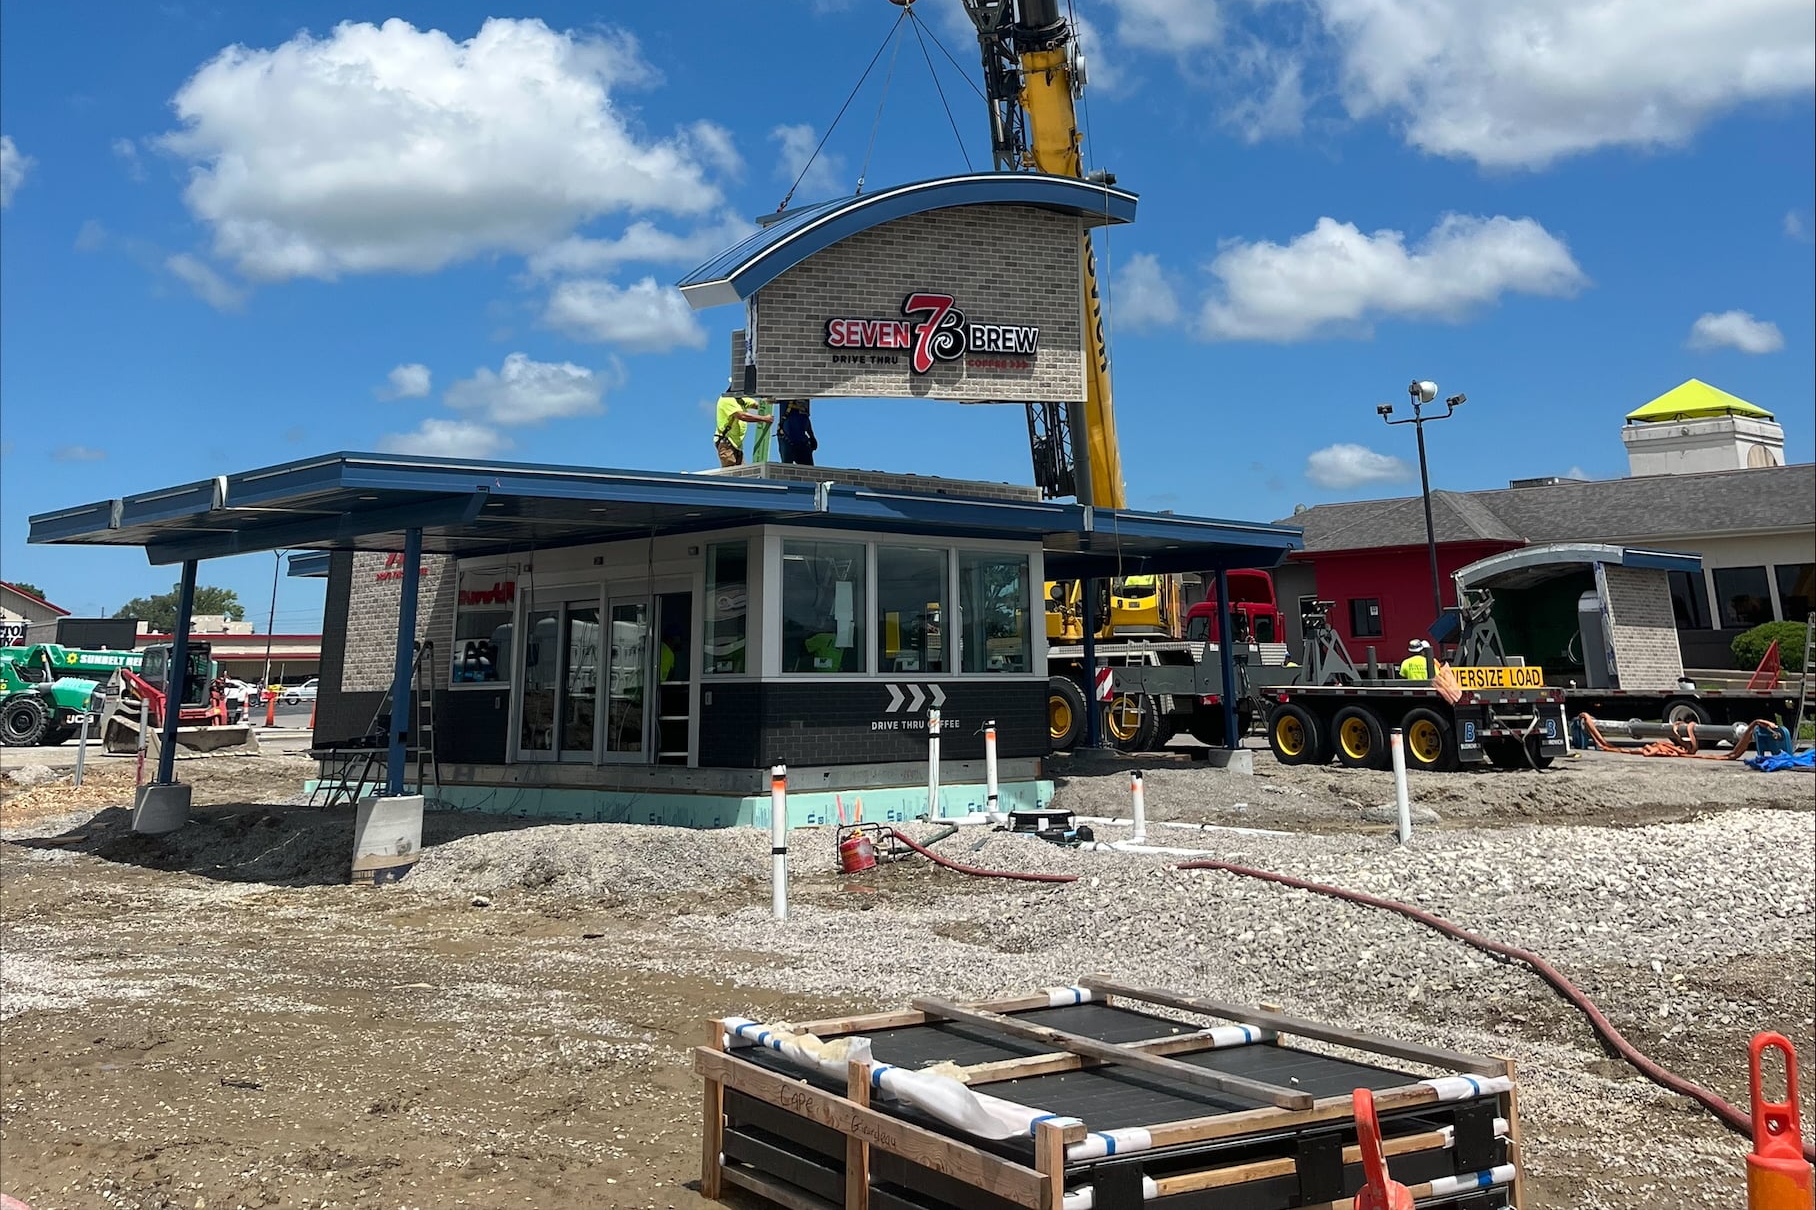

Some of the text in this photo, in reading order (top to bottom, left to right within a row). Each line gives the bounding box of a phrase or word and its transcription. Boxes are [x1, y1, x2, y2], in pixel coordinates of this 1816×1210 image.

[828, 318, 911, 349] SEVEN
[969, 323, 1039, 355] BREW
[832, 355, 866, 364] DRIVE
[870, 356, 899, 365] THRU
[80, 654, 125, 666] SUNBELT
[1451, 668, 1540, 687] VERSIZE LOAD
[66, 714, 95, 724] JCB
[871, 719, 960, 730] DRIVE THRU CFFEE
[780, 1084, 814, 1112] Cape
